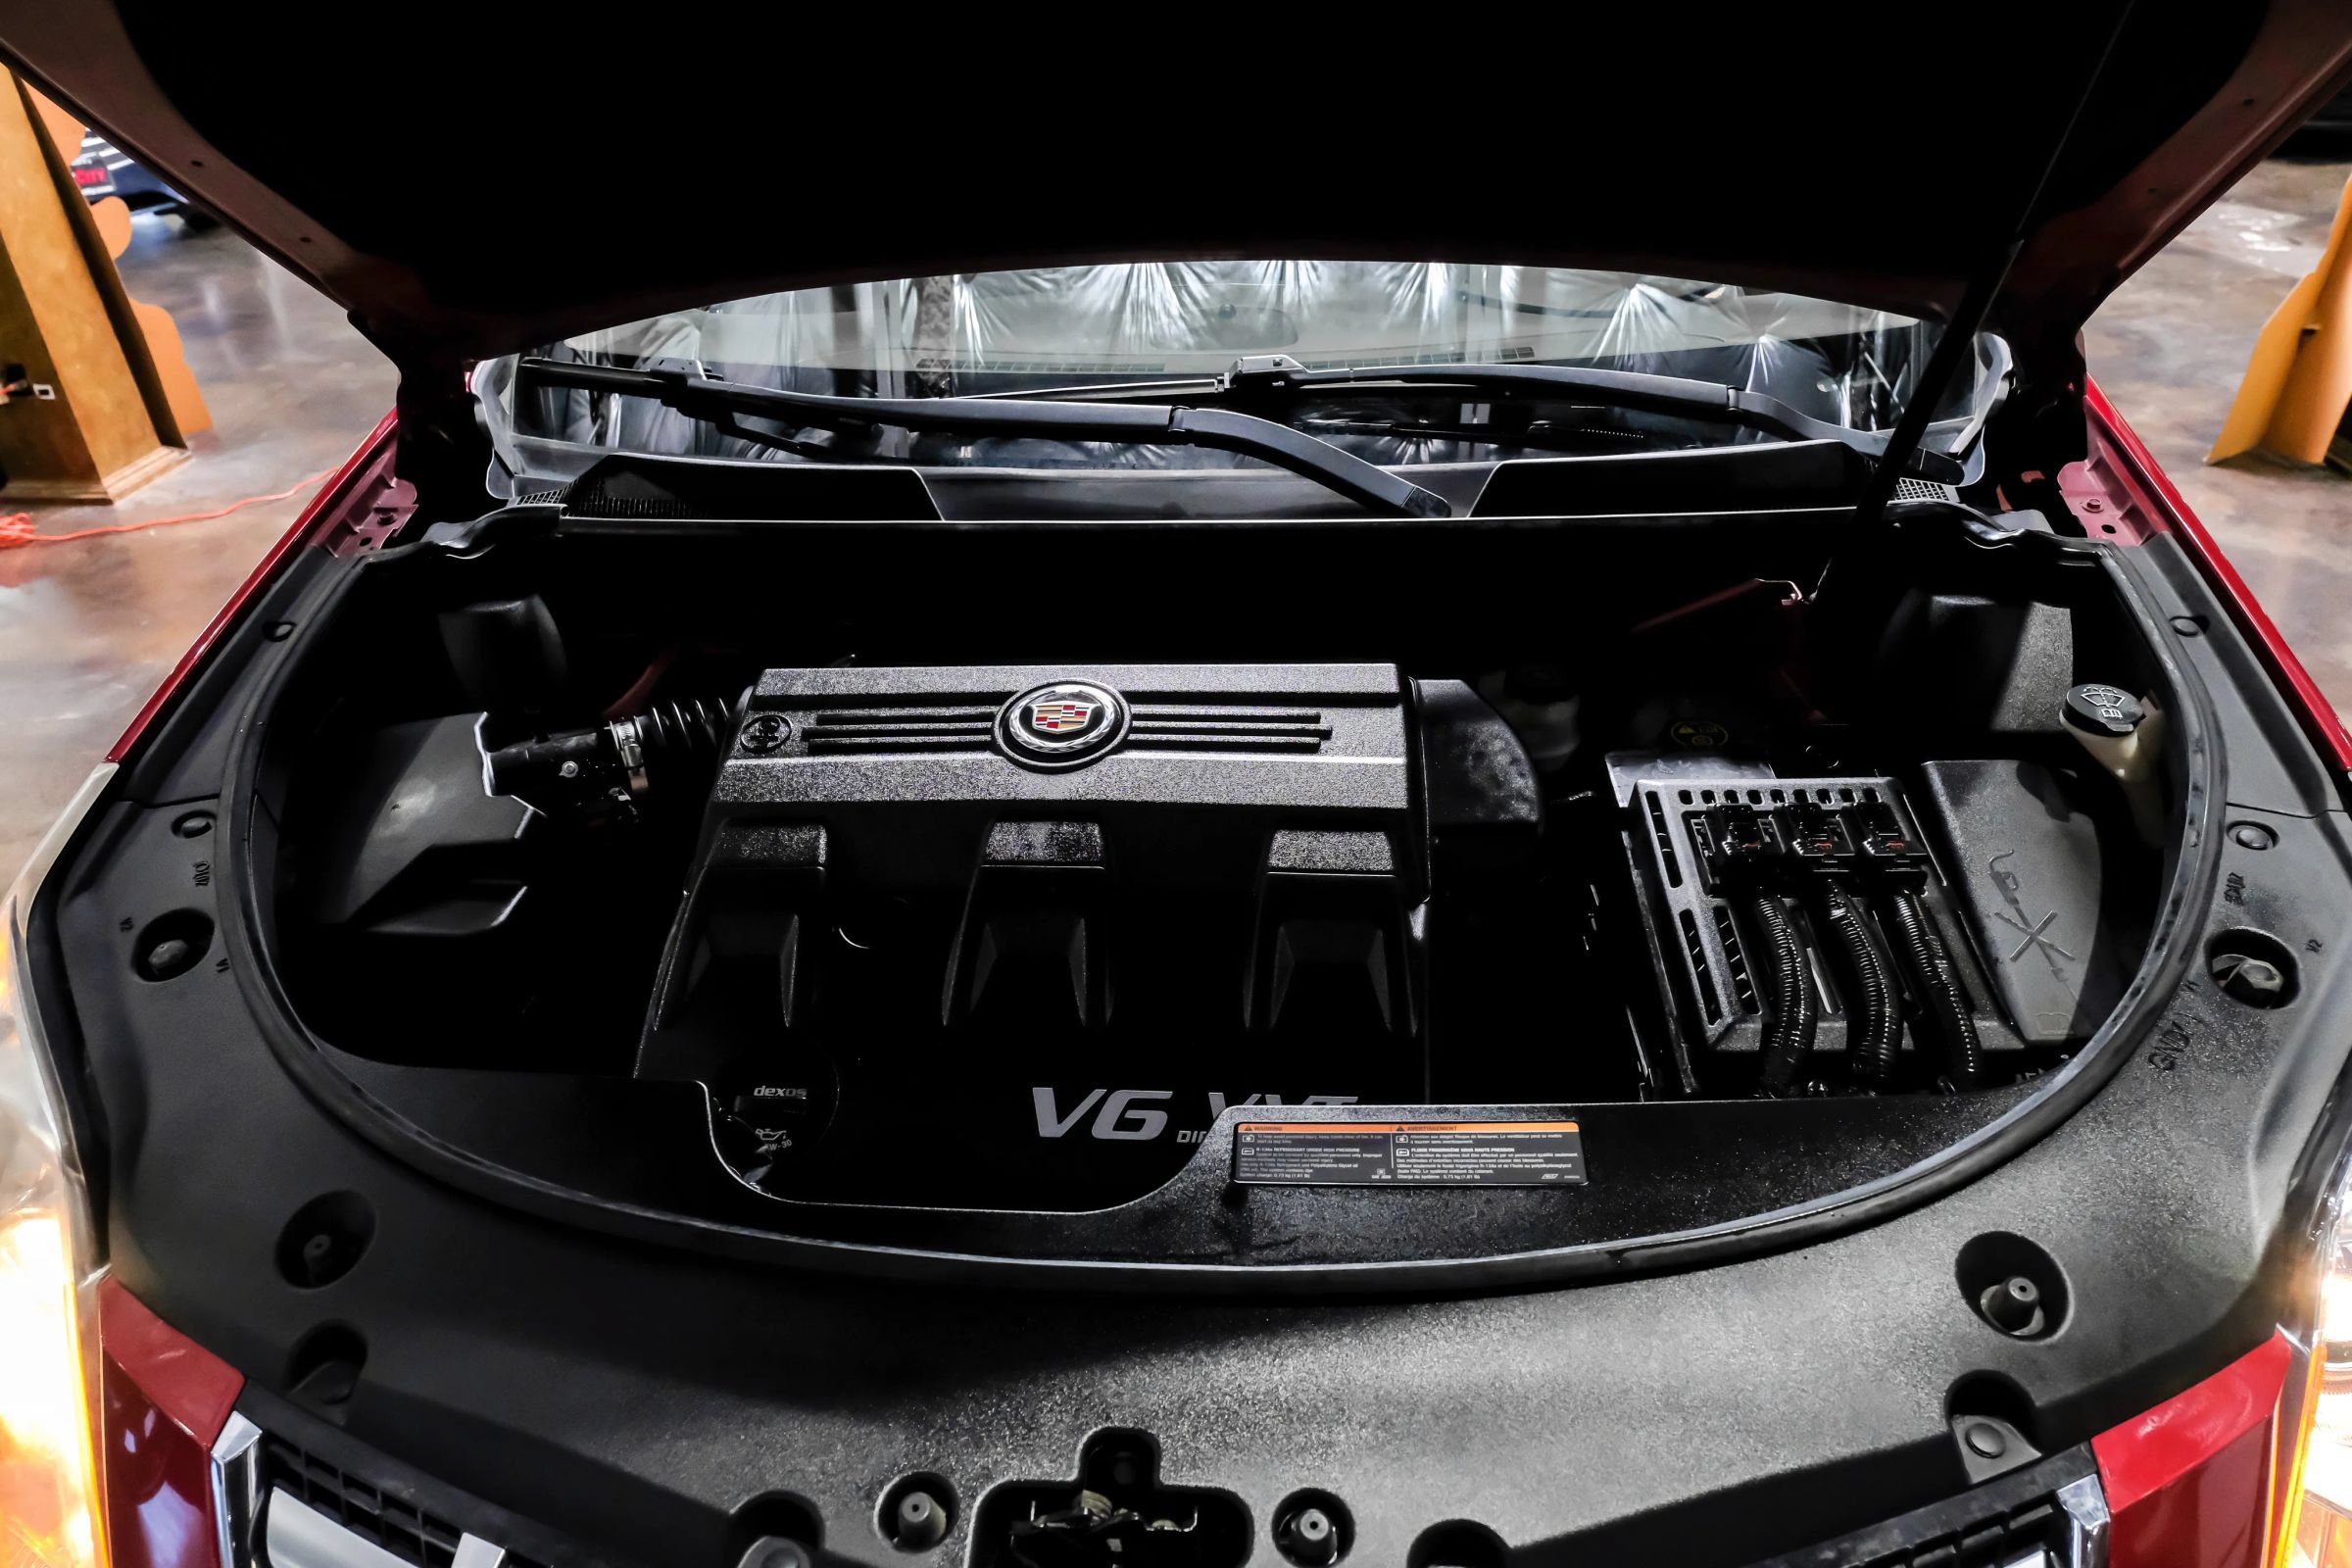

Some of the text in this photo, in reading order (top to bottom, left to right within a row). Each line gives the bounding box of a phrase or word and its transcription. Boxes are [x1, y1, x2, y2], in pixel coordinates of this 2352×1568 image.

[754, 1085, 808, 1097] dexos
[1032, 1087, 1173, 1141] V6
[765, 1139, 793, 1152] W-30
